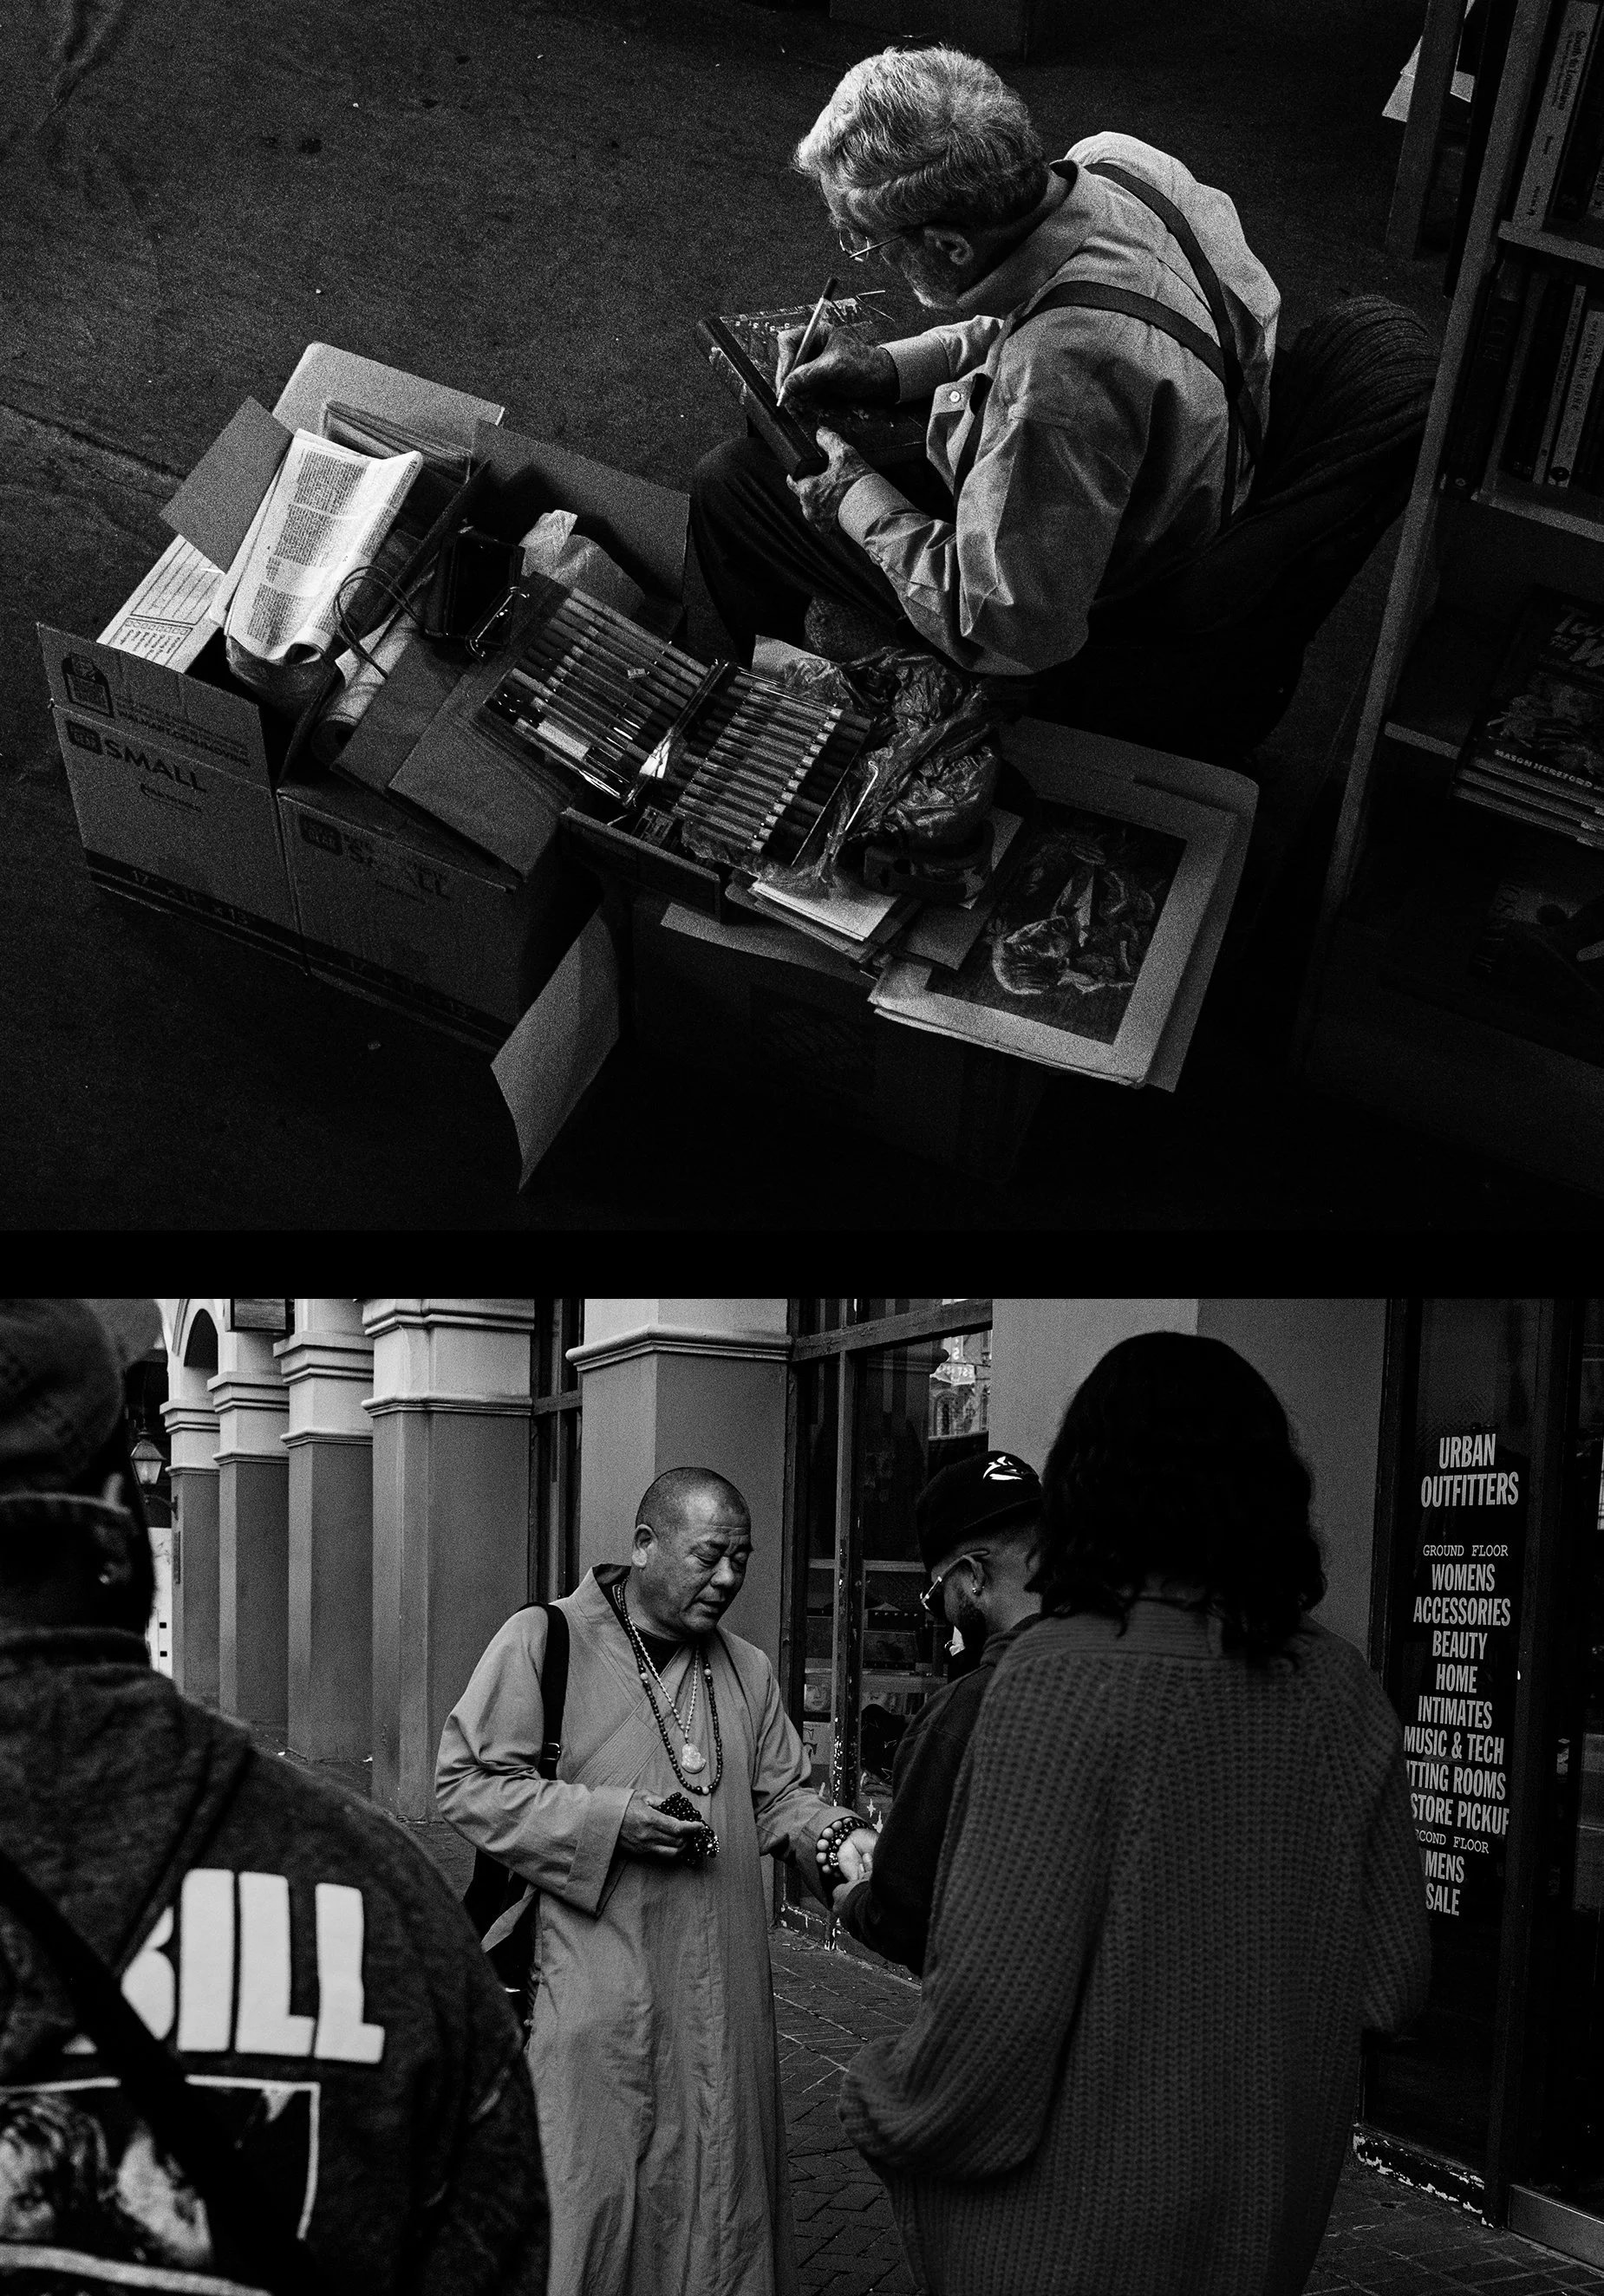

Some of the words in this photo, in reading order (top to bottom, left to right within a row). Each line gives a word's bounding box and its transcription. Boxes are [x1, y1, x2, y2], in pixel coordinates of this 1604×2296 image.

[103, 738, 207, 793] SMALL
[349, 843, 451, 899] SLL
[1438, 1433, 1496, 1470] URBAN
[1420, 1471, 1519, 1508] OUTFITTERS
[1423, 1544, 1464, 1557] GROUND
[1471, 1544, 1509, 1557] FLOOR
[1431, 1563, 1496, 1592] WOMENS
[1412, 1596, 1511, 1627] ACCESSORIES
[1431, 1630, 1488, 1660] BEAUTY
[1435, 1663, 1478, 1693] HOME
[1418, 1695, 1493, 1730] INTIMATES
[1403, 1725, 1447, 1757] MUSIC
[1451, 1732, 1463, 1759] &
[1467, 1733, 1504, 1765] TECH
[1453, 1764, 1506, 1801] ROOMS
[1410, 1792, 1454, 1826] STORE
[1453, 1836, 1490, 1854] FLOOR
[1425, 1849, 1465, 1883] MENS
[1425, 1882, 1461, 1916] SALE
